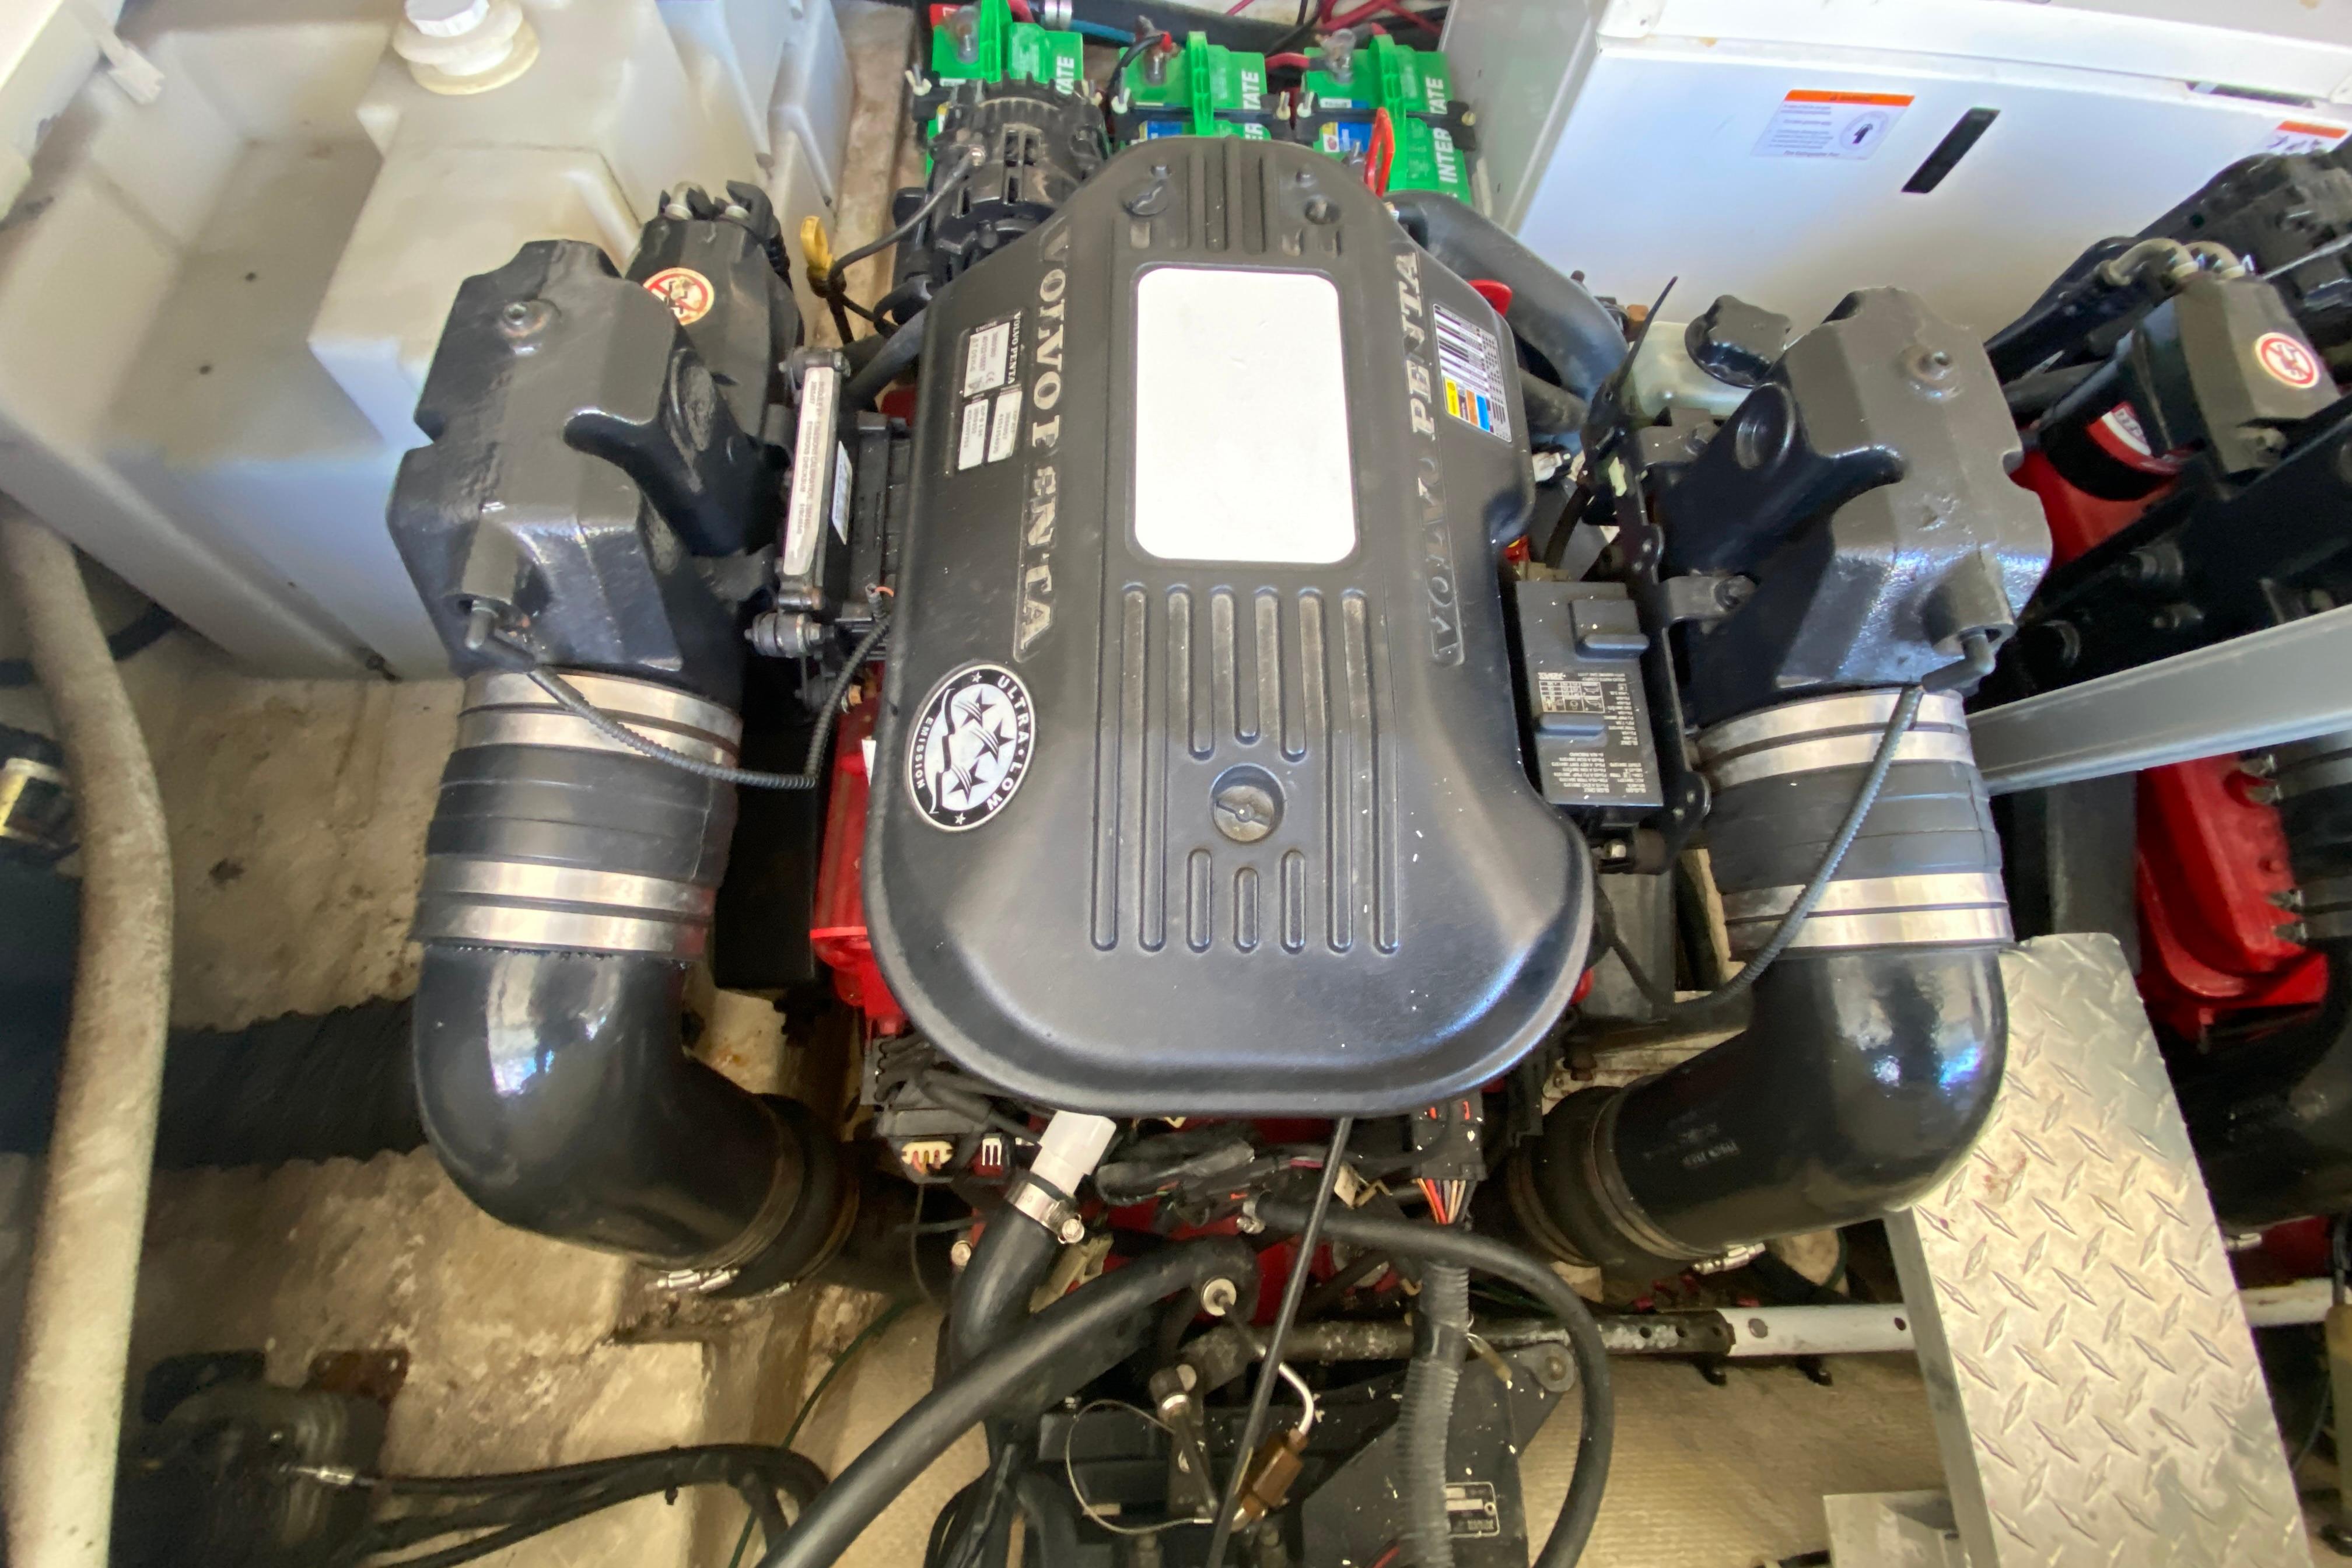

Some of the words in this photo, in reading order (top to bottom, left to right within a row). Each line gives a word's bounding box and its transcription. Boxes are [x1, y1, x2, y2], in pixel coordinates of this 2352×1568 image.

[975, 321, 998, 333] ENGINE
[1012, 310, 1021, 345] VOLVO
[1034, 225, 1072, 410] VOLVO
[1008, 346, 1019, 384] PENTA
[1020, 414, 1060, 651] PENTA
[996, 675, 1030, 743] ULTRA
[915, 717, 933, 789] EMISSION
[986, 766, 1022, 810] LOW
